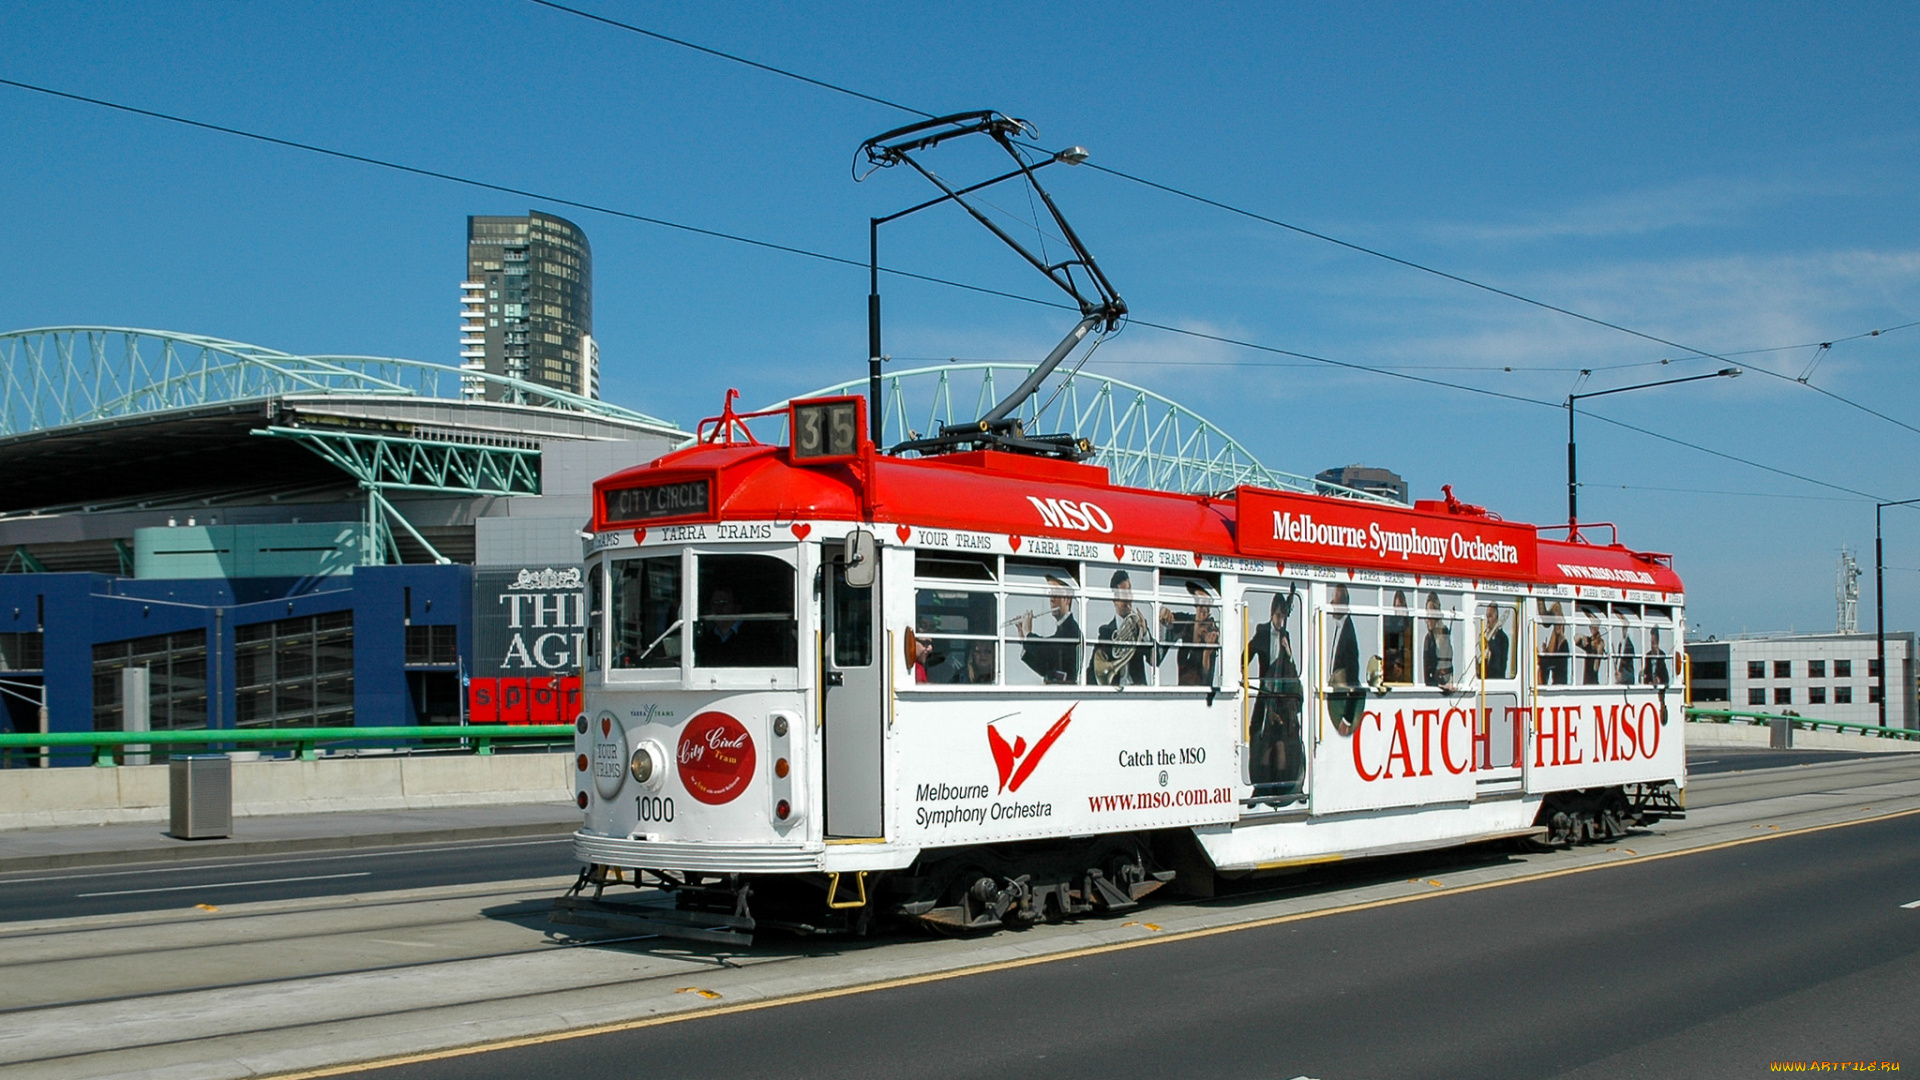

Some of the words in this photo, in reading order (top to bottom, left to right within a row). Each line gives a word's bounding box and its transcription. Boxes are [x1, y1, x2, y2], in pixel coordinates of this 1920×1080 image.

[801, 408, 854, 449] 35
[620, 490, 652, 513] CITY
[657, 484, 705, 509] CIRCLE
[1026, 496, 1114, 533] MSO
[662, 525, 706, 541] YARRA
[717, 524, 771, 539] TRAMS
[918, 530, 948, 546] YOUR
[956, 533, 991, 549] TRAMS
[1273, 511, 1366, 548] Melbourne
[1369, 522, 1448, 564] Symphony
[1451, 532, 1518, 564] Orchestra
[1028, 540, 1060, 555] YARRA
[1067, 543, 1098, 558] TRAMS
[1130, 549, 1154, 563] YOUR
[1159, 552, 1187, 567] TRAMS
[1208, 556, 1234, 570] YARRA
[1239, 559, 1264, 572] TRAMS
[1290, 563, 1309, 576] YOUR
[1313, 565, 1336, 578] TRAMS
[1557, 564, 1656, 584] www.mso.com.au
[597, 743, 617, 759] YOUR
[677, 739, 705, 764] City
[705, 727, 748, 750] Circle
[1352, 707, 1494, 782] CATCH
[1504, 705, 1583, 769] THE
[1593, 702, 1660, 763] MSO
[714, 749, 737, 764] Tram
[1118, 750, 1153, 767] Catch
[1157, 749, 1176, 765] the
[1179, 747, 1206, 764] MSO
[596, 762, 621, 778] TRAMS
[1158, 770, 1169, 787] @
[916, 783, 989, 801] Melbourne
[1088, 787, 1231, 813] www.mso.com.au
[635, 795, 674, 822] 1000
[916, 805, 987, 829] Symphony
[991, 801, 1052, 820] Orchestra
